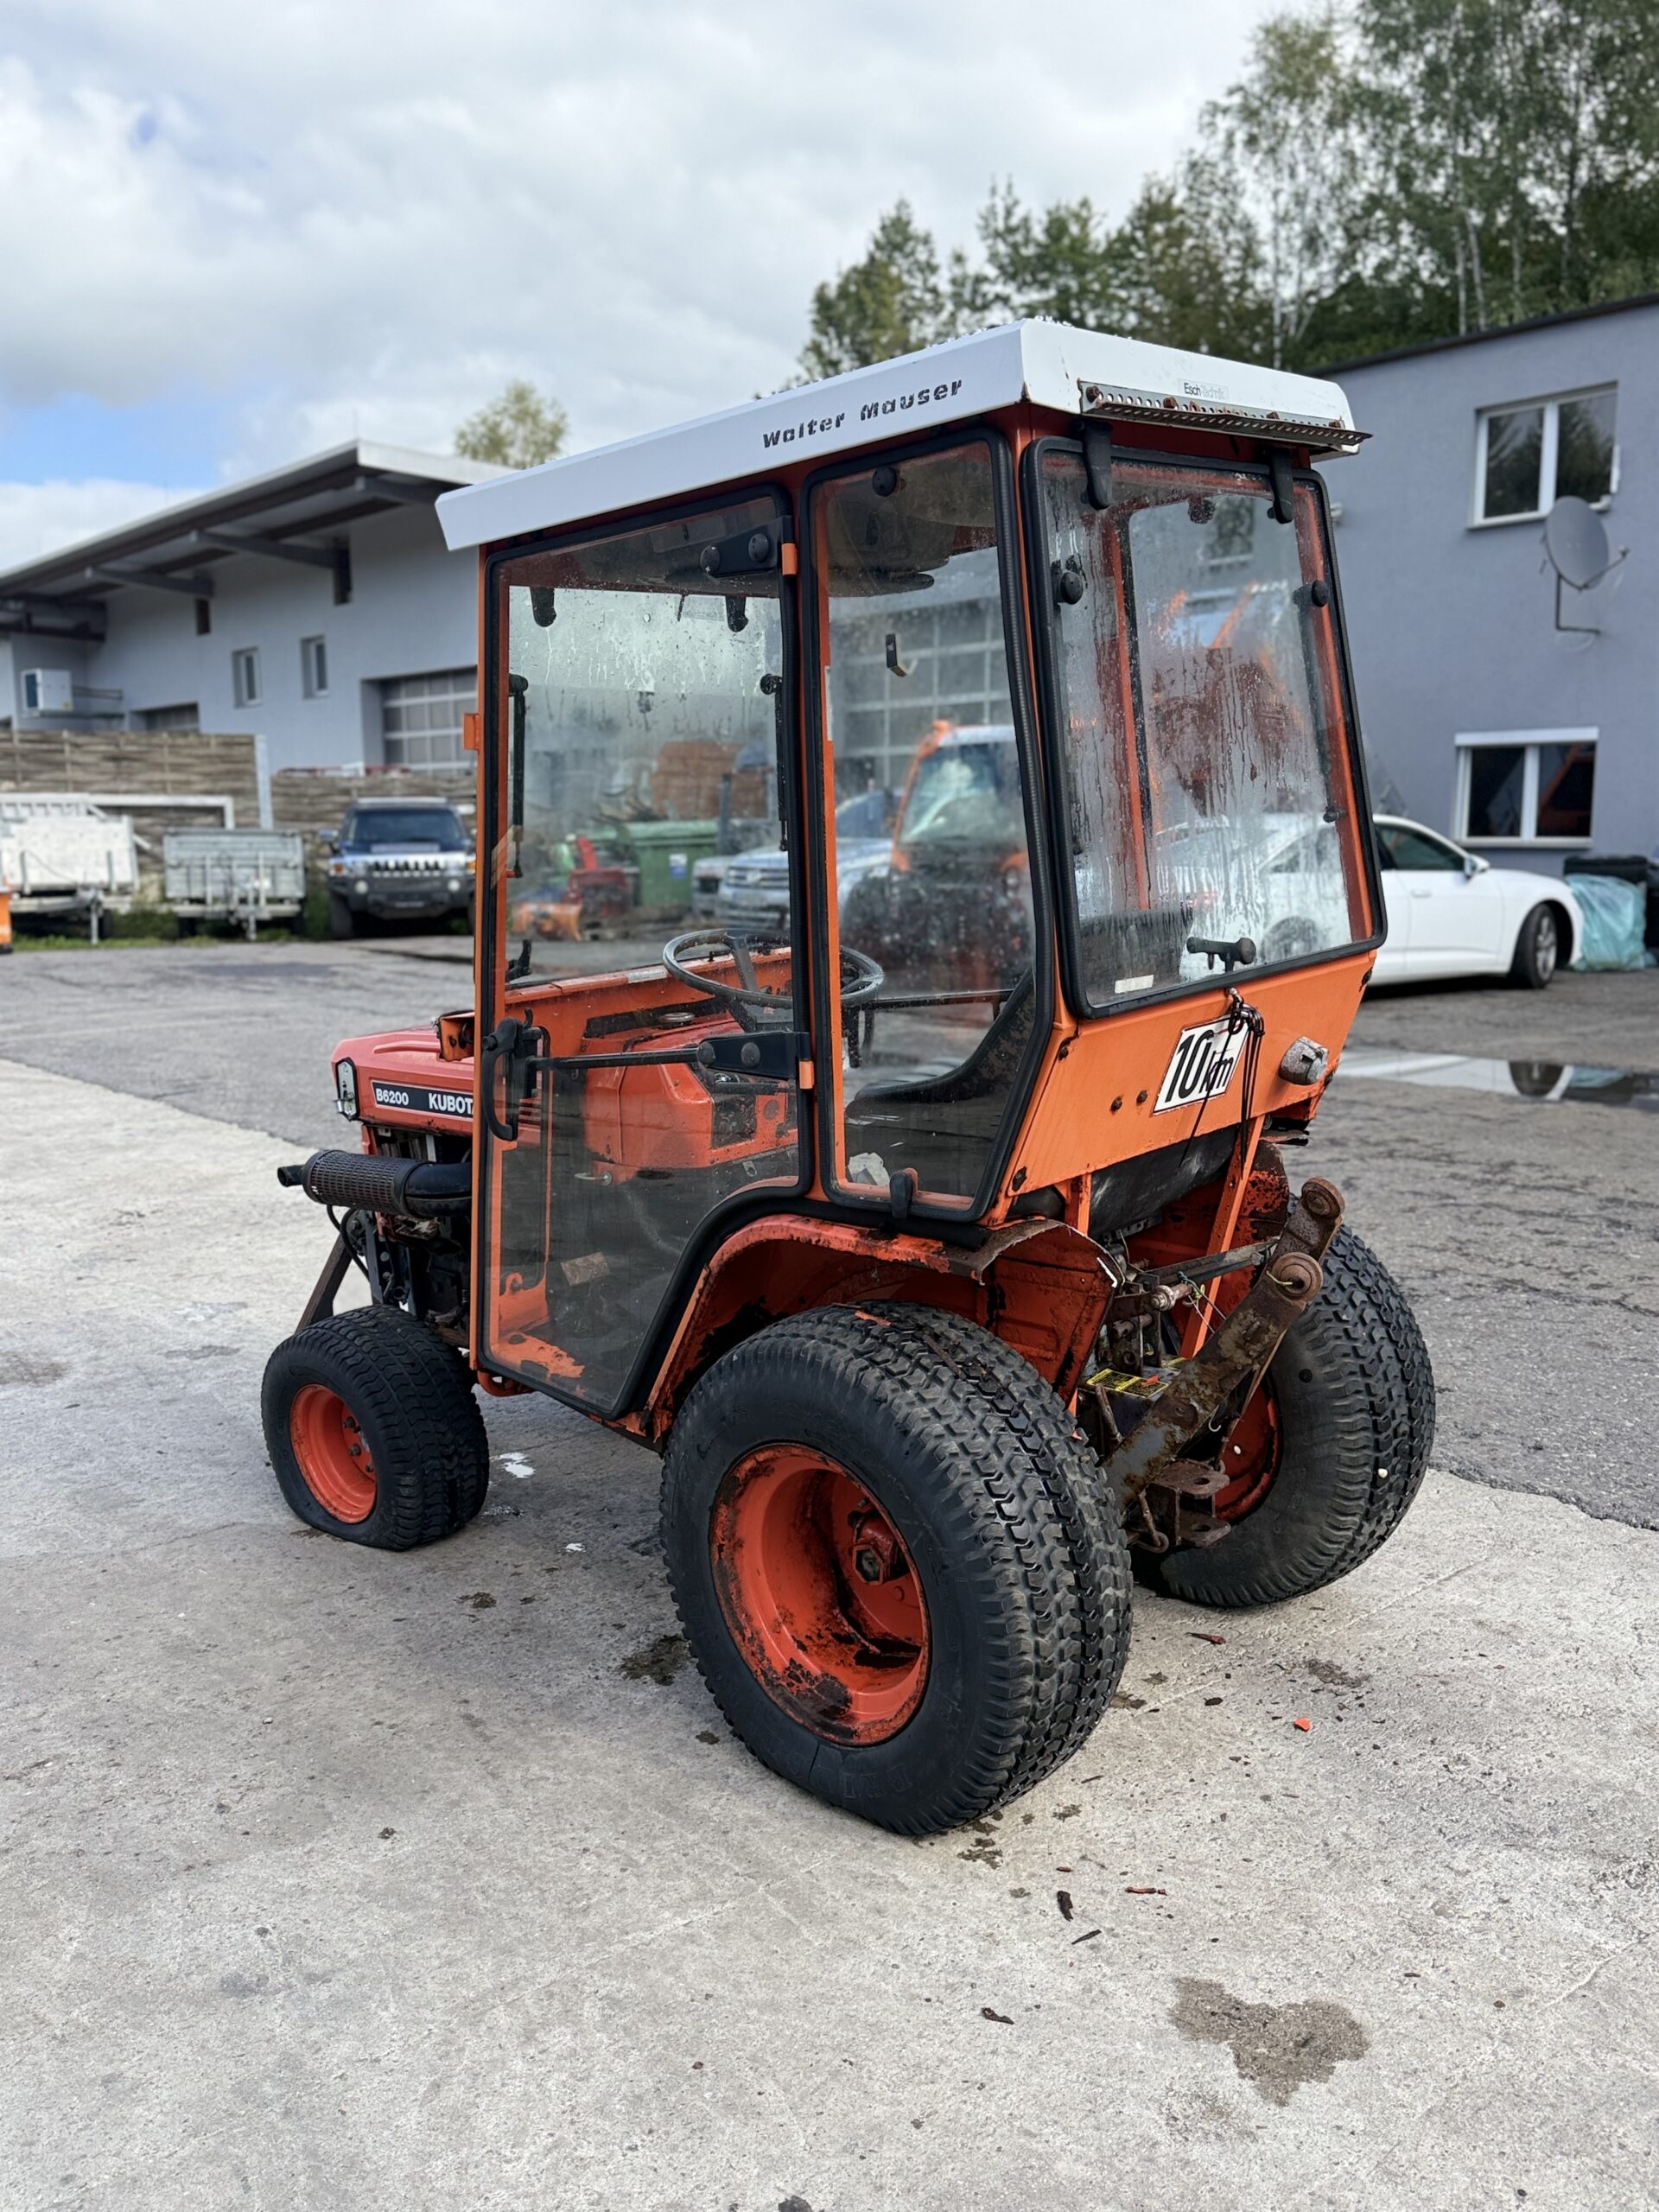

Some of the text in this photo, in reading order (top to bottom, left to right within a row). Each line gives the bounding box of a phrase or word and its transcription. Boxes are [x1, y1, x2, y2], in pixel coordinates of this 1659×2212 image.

[762, 379, 963, 449] Walter Mauser
[375, 1088, 410, 1106] B6200
[428, 1092, 474, 1115] KUBOT
